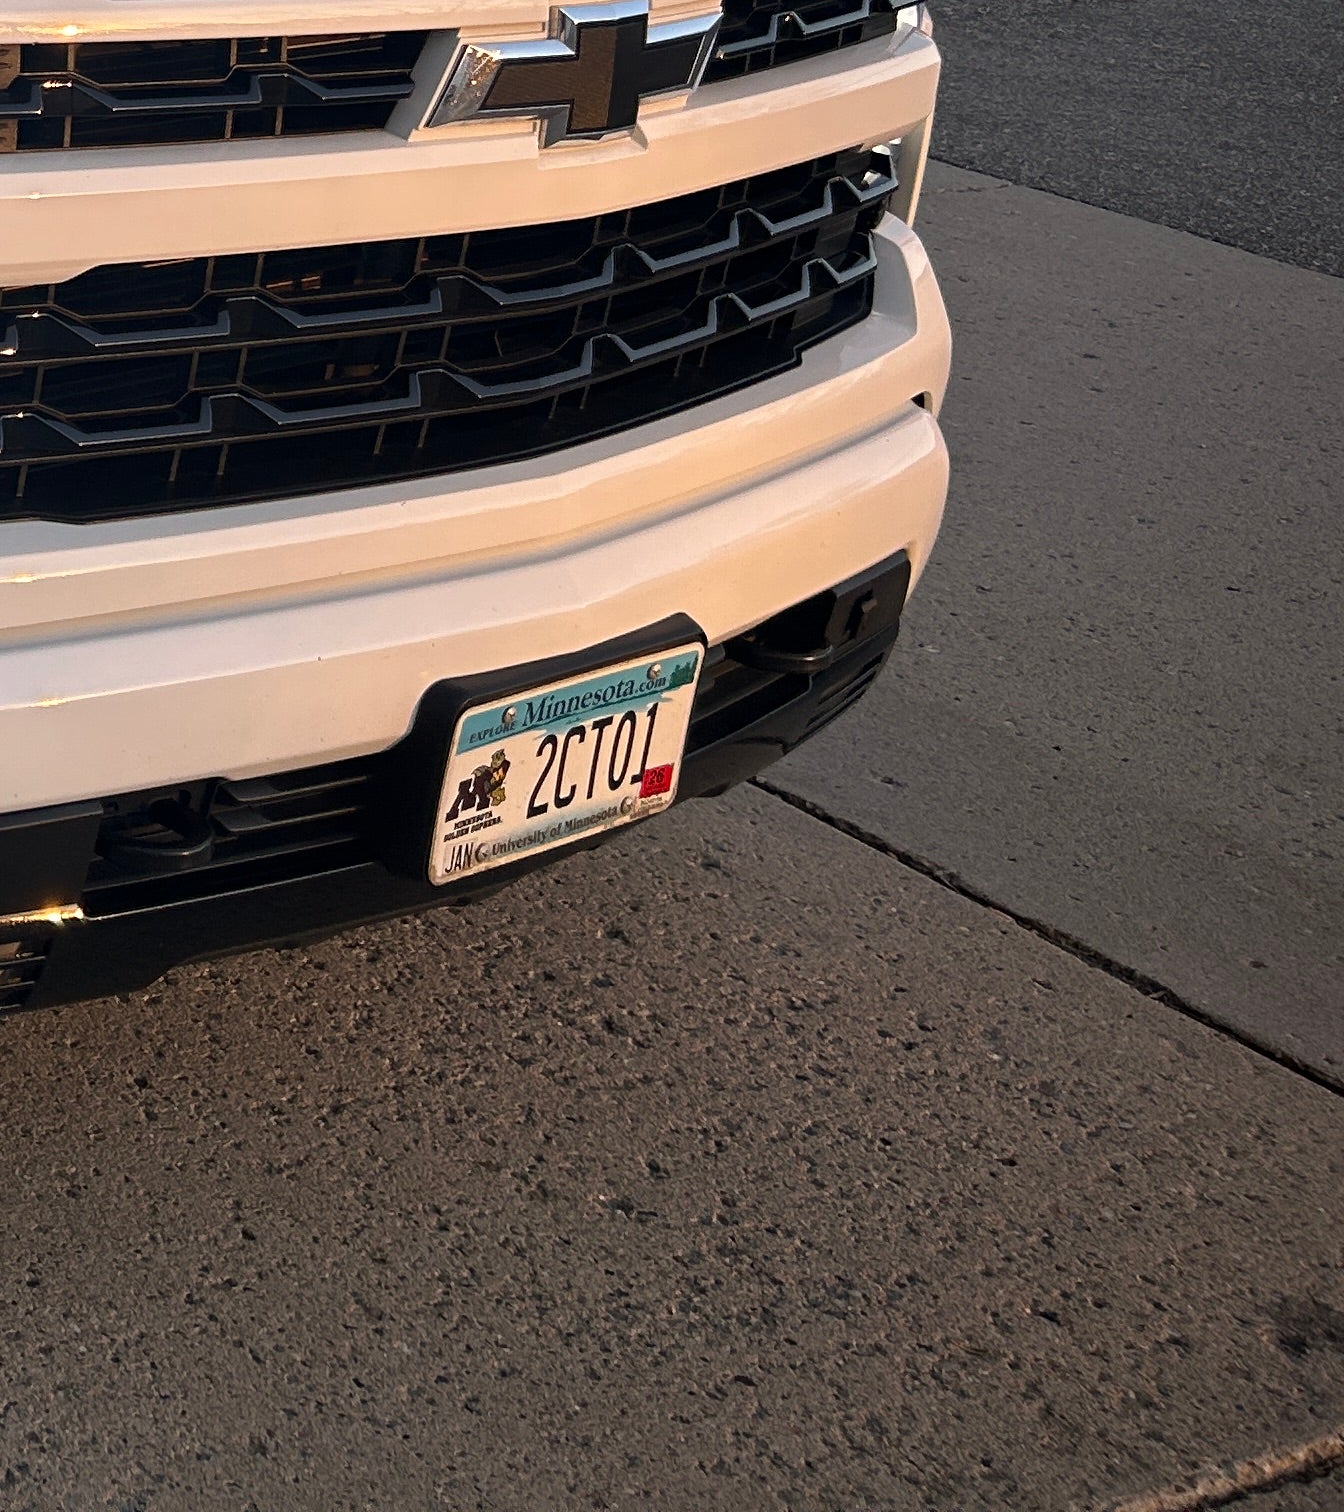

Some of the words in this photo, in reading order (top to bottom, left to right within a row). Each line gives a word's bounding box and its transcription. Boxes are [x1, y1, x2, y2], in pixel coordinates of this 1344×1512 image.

[469, 723, 515, 743] EXPLORE
[522, 676, 667, 727] Minnesota.com
[492, 830, 547, 856] University
[550, 824, 563, 838] of
[564, 806, 619, 833] Minnesota
[445, 842, 474, 874] JAN
